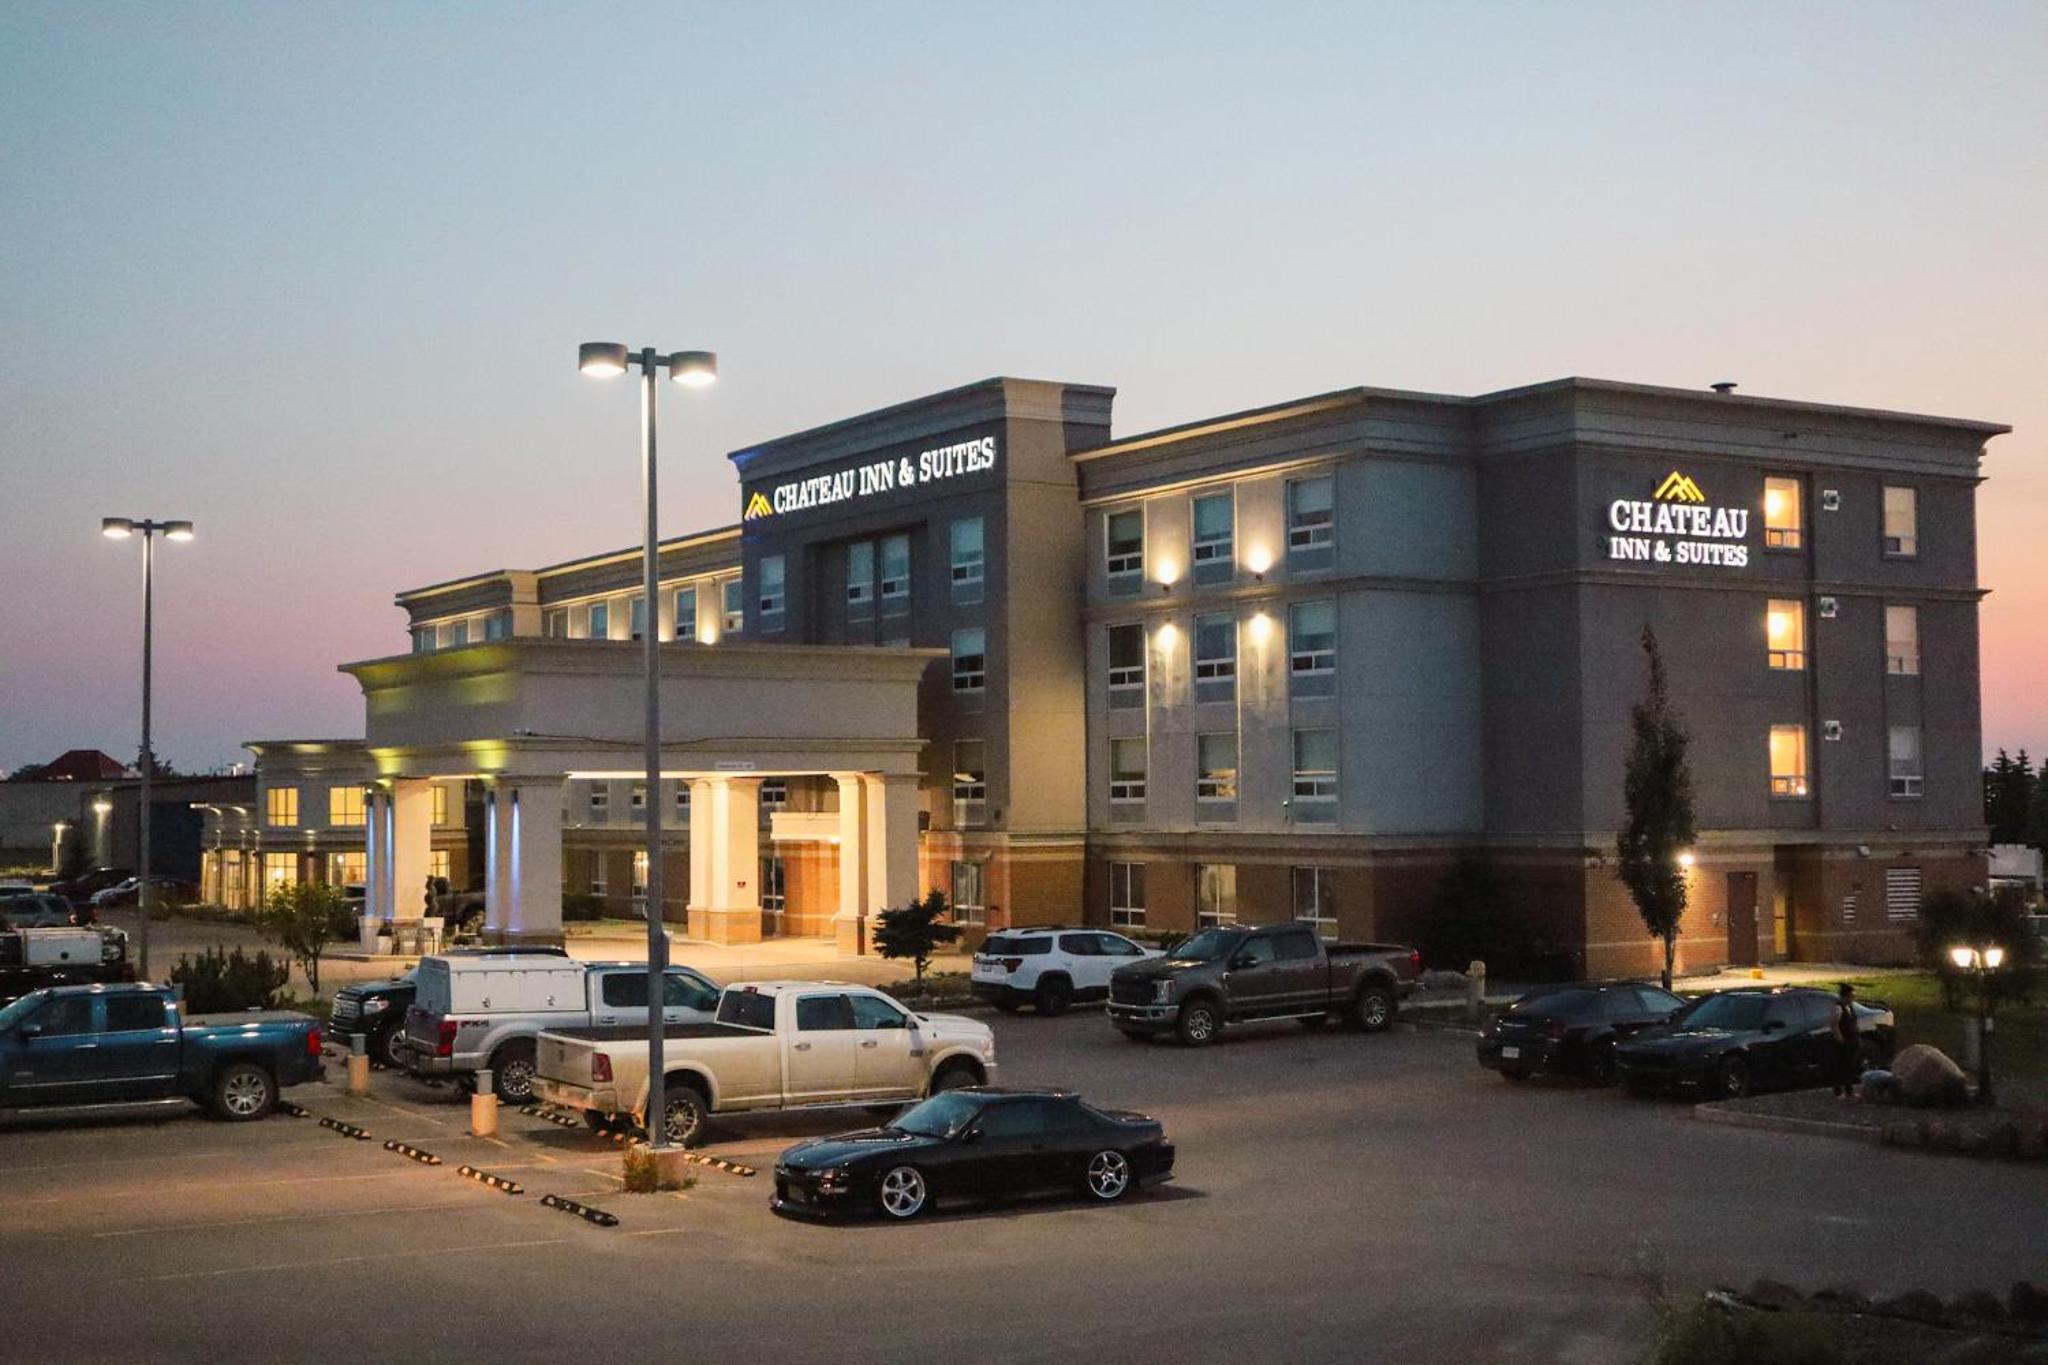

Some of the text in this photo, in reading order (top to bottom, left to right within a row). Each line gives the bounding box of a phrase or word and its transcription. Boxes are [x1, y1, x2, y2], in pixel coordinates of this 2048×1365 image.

[774, 437, 995, 514] CHATEAU INN & SUITES
[1611, 500, 1748, 538] CHATEAU
[1610, 537, 1749, 567] INN & SUITES
